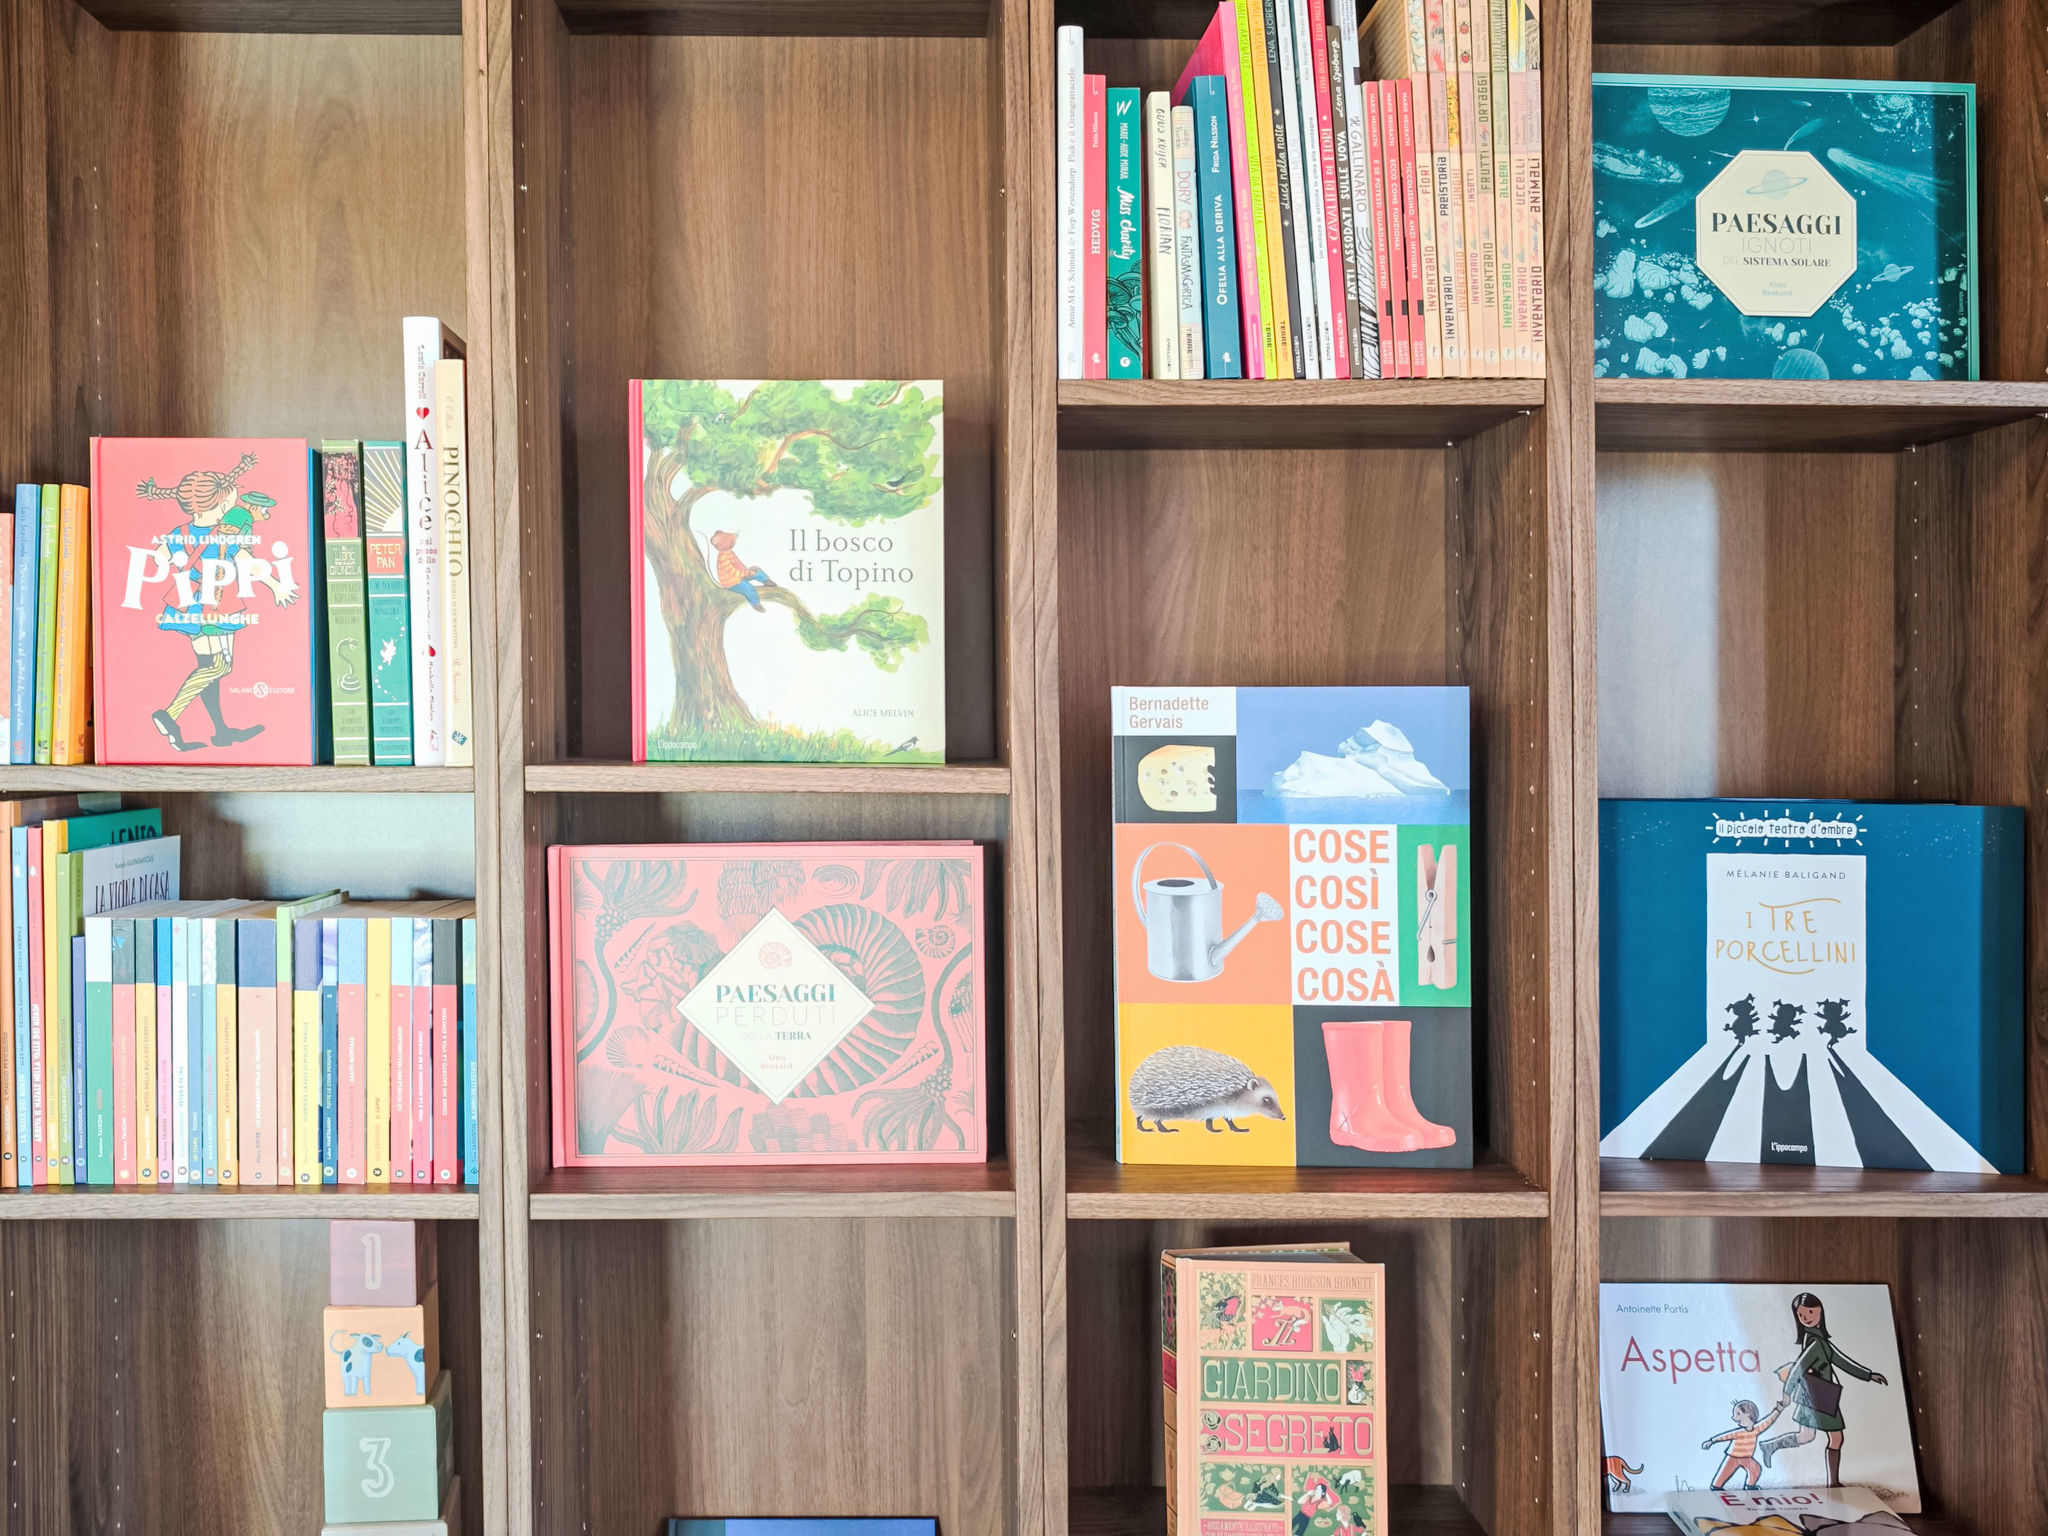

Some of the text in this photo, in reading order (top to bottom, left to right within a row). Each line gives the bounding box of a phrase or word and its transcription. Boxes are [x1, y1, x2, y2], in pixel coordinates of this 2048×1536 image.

[1268, 40, 1277, 64] LENA
[1067, 68, 1078, 162] Pluk Grangrattacielo
[1156, 108, 1166, 134] GUUS
[1119, 122, 1129, 180] MARIE-AUDE MURAIL
[1321, 128, 1334, 161] FIORI
[1275, 124, 1290, 210] Luci nella notte
[1350, 130, 1368, 212] GALLINARIO
[1066, 167, 1077, 215] Westendorp
[1117, 186, 1135, 215] Miss
[1324, 180, 1338, 240] CAVALIERI
[1336, 131, 1357, 300] FATTI ASSODATI SULLE UOVA
[1374, 166, 1380, 175] SE
[1377, 211, 1385, 252] GUARDARE
[1711, 212, 1842, 236] PAESAGGI
[1066, 217, 1077, 234] Fiep
[1091, 209, 1101, 254] HEDVIG
[1156, 207, 1172, 255] FLORIAN
[1177, 170, 1194, 310] DORY FANTASMAGORICA
[1214, 194, 1228, 305] OFELIA ALLA DERIVA
[1742, 237, 1812, 254] IGNOTI
[1066, 249, 1076, 281] Schmidt
[1742, 256, 1788, 267] SISTEMA
[1790, 257, 1832, 268] SOLARE
[414, 429, 434, 531] Alice
[152, 535, 261, 545] ASTRID LINDGREN
[370, 543, 402, 555] PETER
[790, 528, 894, 554] Il bosco
[120, 541, 294, 610] Pippi
[376, 556, 396, 568] PAN
[789, 560, 914, 591] di Topino
[156, 613, 260, 626] CALZELUNGHE
[228, 686, 295, 694] SALANI EDITORE
[1128, 696, 1210, 712] Bernadette
[852, 708, 914, 718] ALICE MELVIN
[1128, 714, 1184, 730] Gervais
[1727, 823, 1764, 837] piccolo
[1768, 823, 1806, 836] teatro
[1810, 823, 1854, 836] d'ombre
[1293, 828, 1390, 866] COSE
[1294, 868, 1379, 911] COSÌ
[1726, 868, 1848, 881] MÉLANIE BALIGAND
[95, 870, 170, 915] LA VICINA DI CASA
[1746, 897, 1843, 935] I TRE
[1295, 920, 1392, 956] COSE
[1715, 938, 1857, 976] PORCELLINI
[716, 983, 836, 1003] PAESAGGI
[1296, 962, 1396, 1003] COSÀ
[715, 1005, 836, 1027] PERDUTI
[774, 1031, 812, 1041] TERRA
[1771, 1142, 1808, 1153] L'ippocampo
[1252, 1274, 1290, 1289] FRANCES
[1334, 1275, 1374, 1290] BURNETT
[1616, 1304, 1688, 1314] Antoinette Portis
[1620, 1336, 1761, 1385] Aspetta
[1203, 1359, 1341, 1402] GIARDINO
[1224, 1412, 1374, 1456] SEGRETO
[359, 1437, 394, 1498] 3
[1750, 1492, 1824, 1506] mio!
